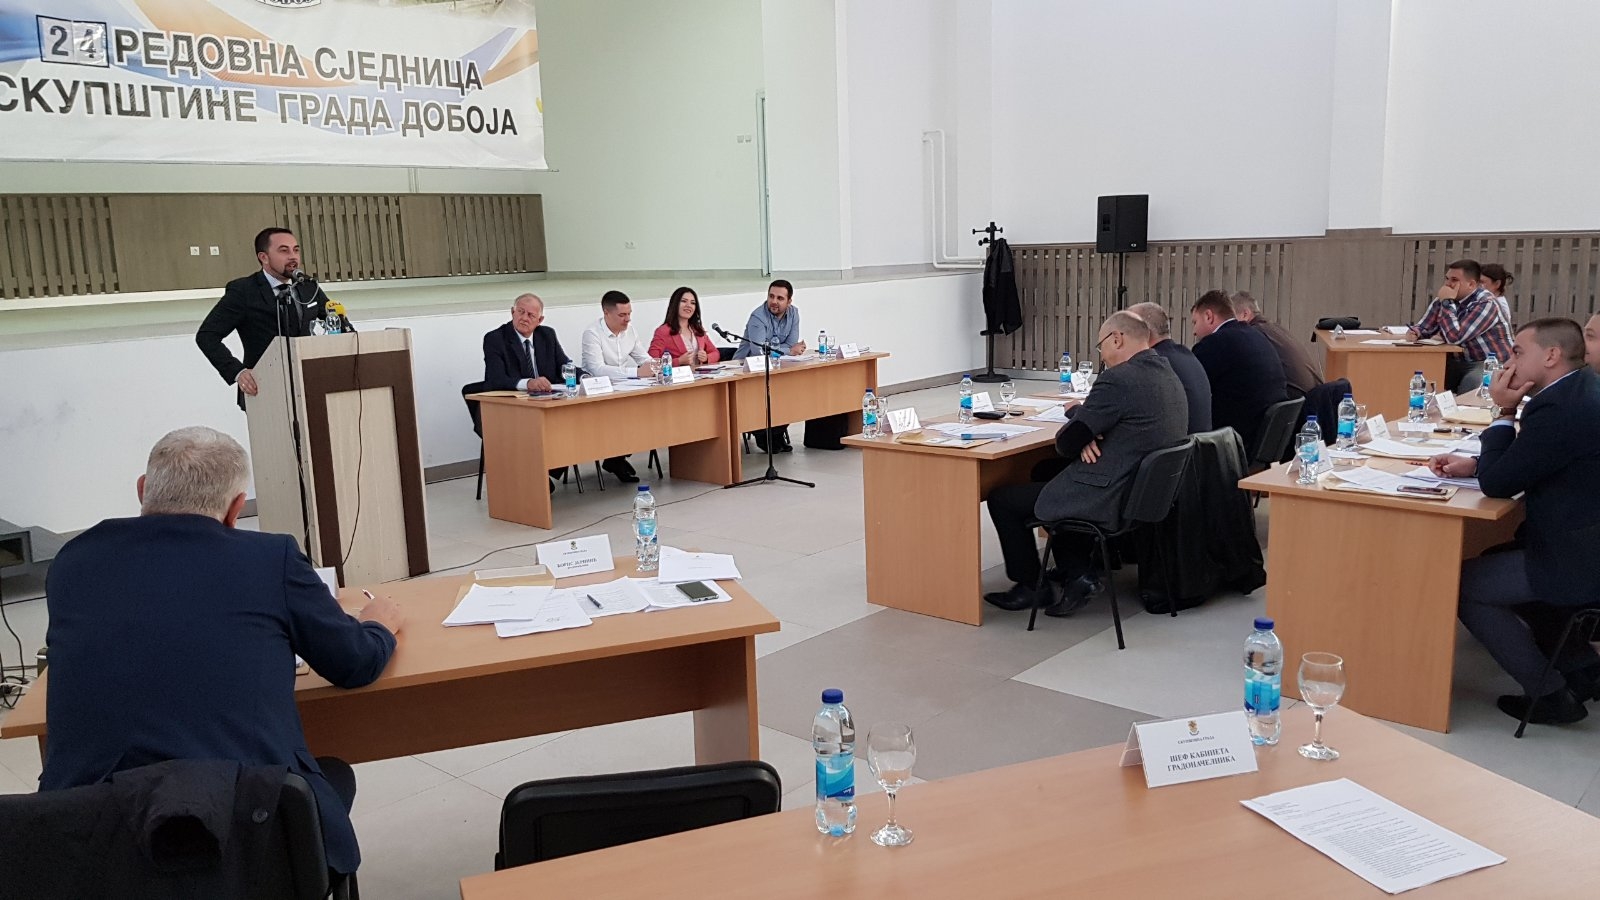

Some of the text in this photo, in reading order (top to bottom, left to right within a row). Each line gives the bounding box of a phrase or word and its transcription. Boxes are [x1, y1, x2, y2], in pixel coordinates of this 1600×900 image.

[50, 25, 483, 96] 24 РЕДОВНА СЈЕДНИЦА
[0, 77, 518, 138] СКУПШТИНЕ ГРАДА ДОБОЈА
[1167, 755, 1236, 772] ГРАДОНАЧЕЛНИКА
[1169, 747, 1230, 763] ШЕФ КАБИНЕТА
